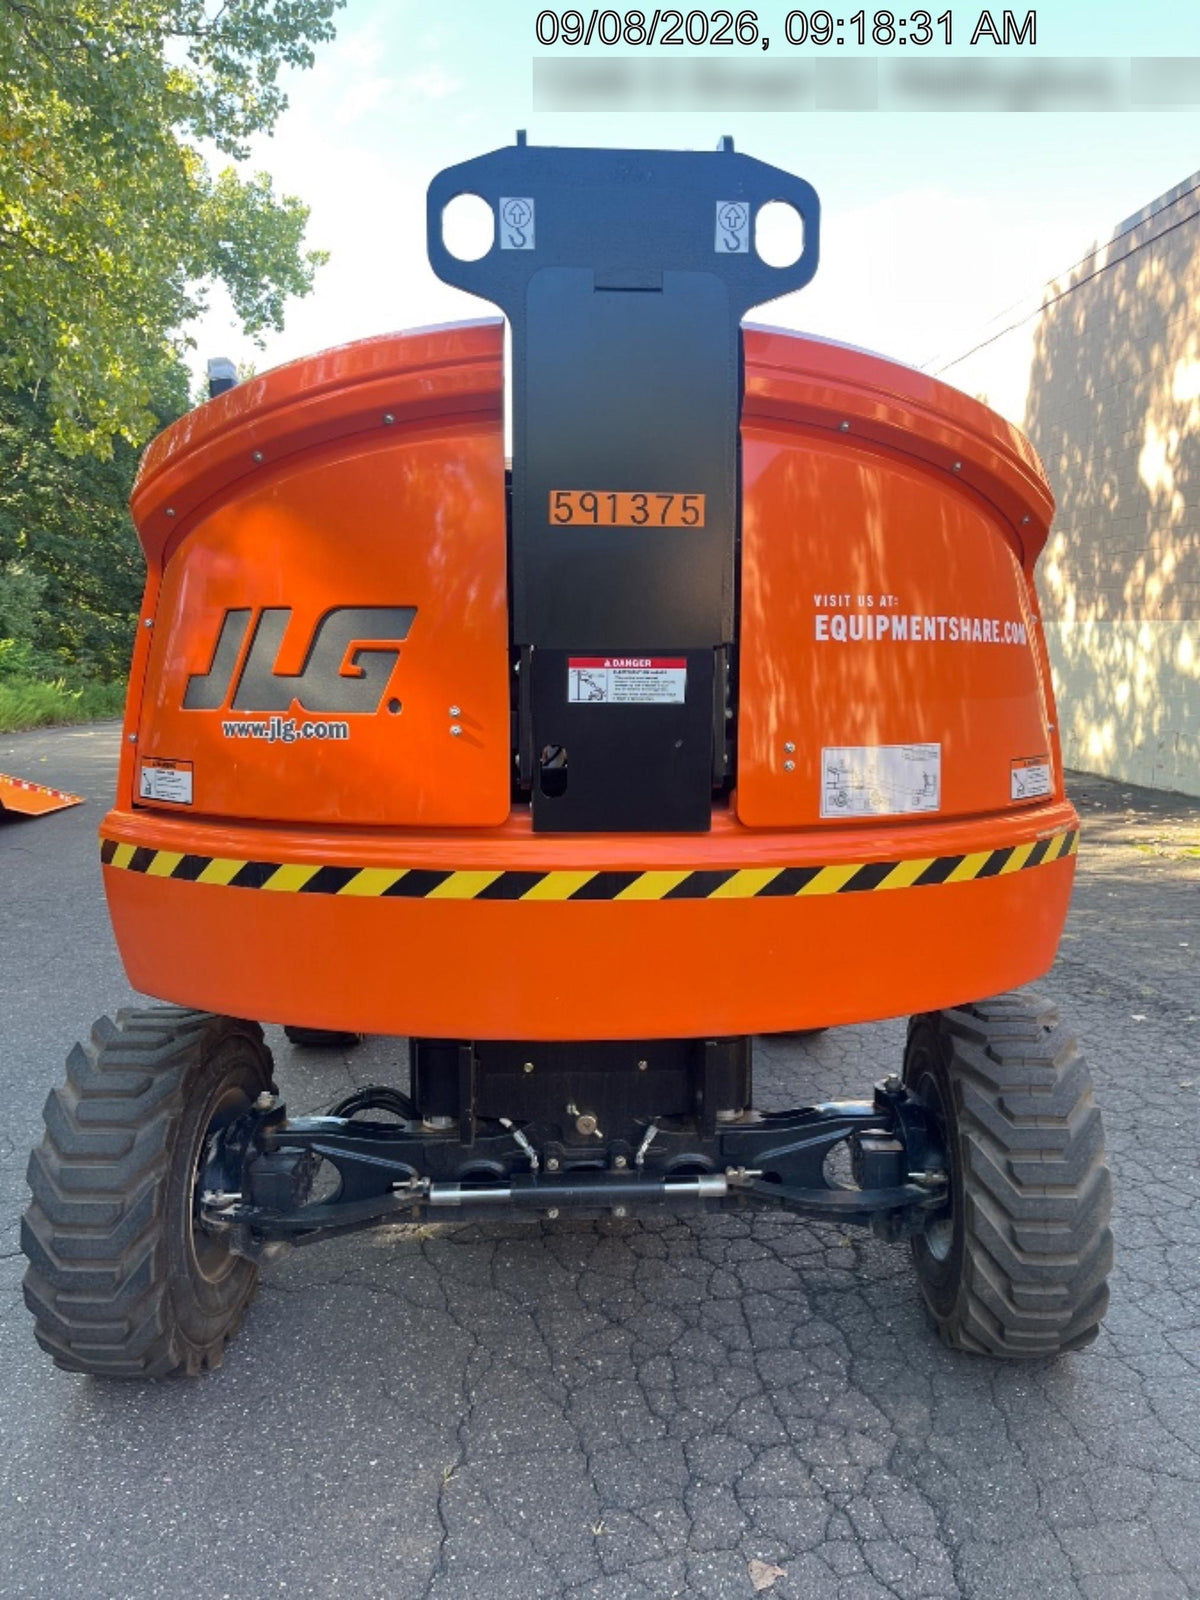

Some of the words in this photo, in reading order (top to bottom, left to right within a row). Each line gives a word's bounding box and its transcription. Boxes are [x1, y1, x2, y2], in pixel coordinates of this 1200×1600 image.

[553, 491, 700, 525] 591375
[814, 594, 851, 607] VISIT
[858, 595, 874, 607] US
[879, 595, 899, 607] AT:
[612, 658, 652, 668] DANGER
[222, 716, 350, 743] www.jlg.com
